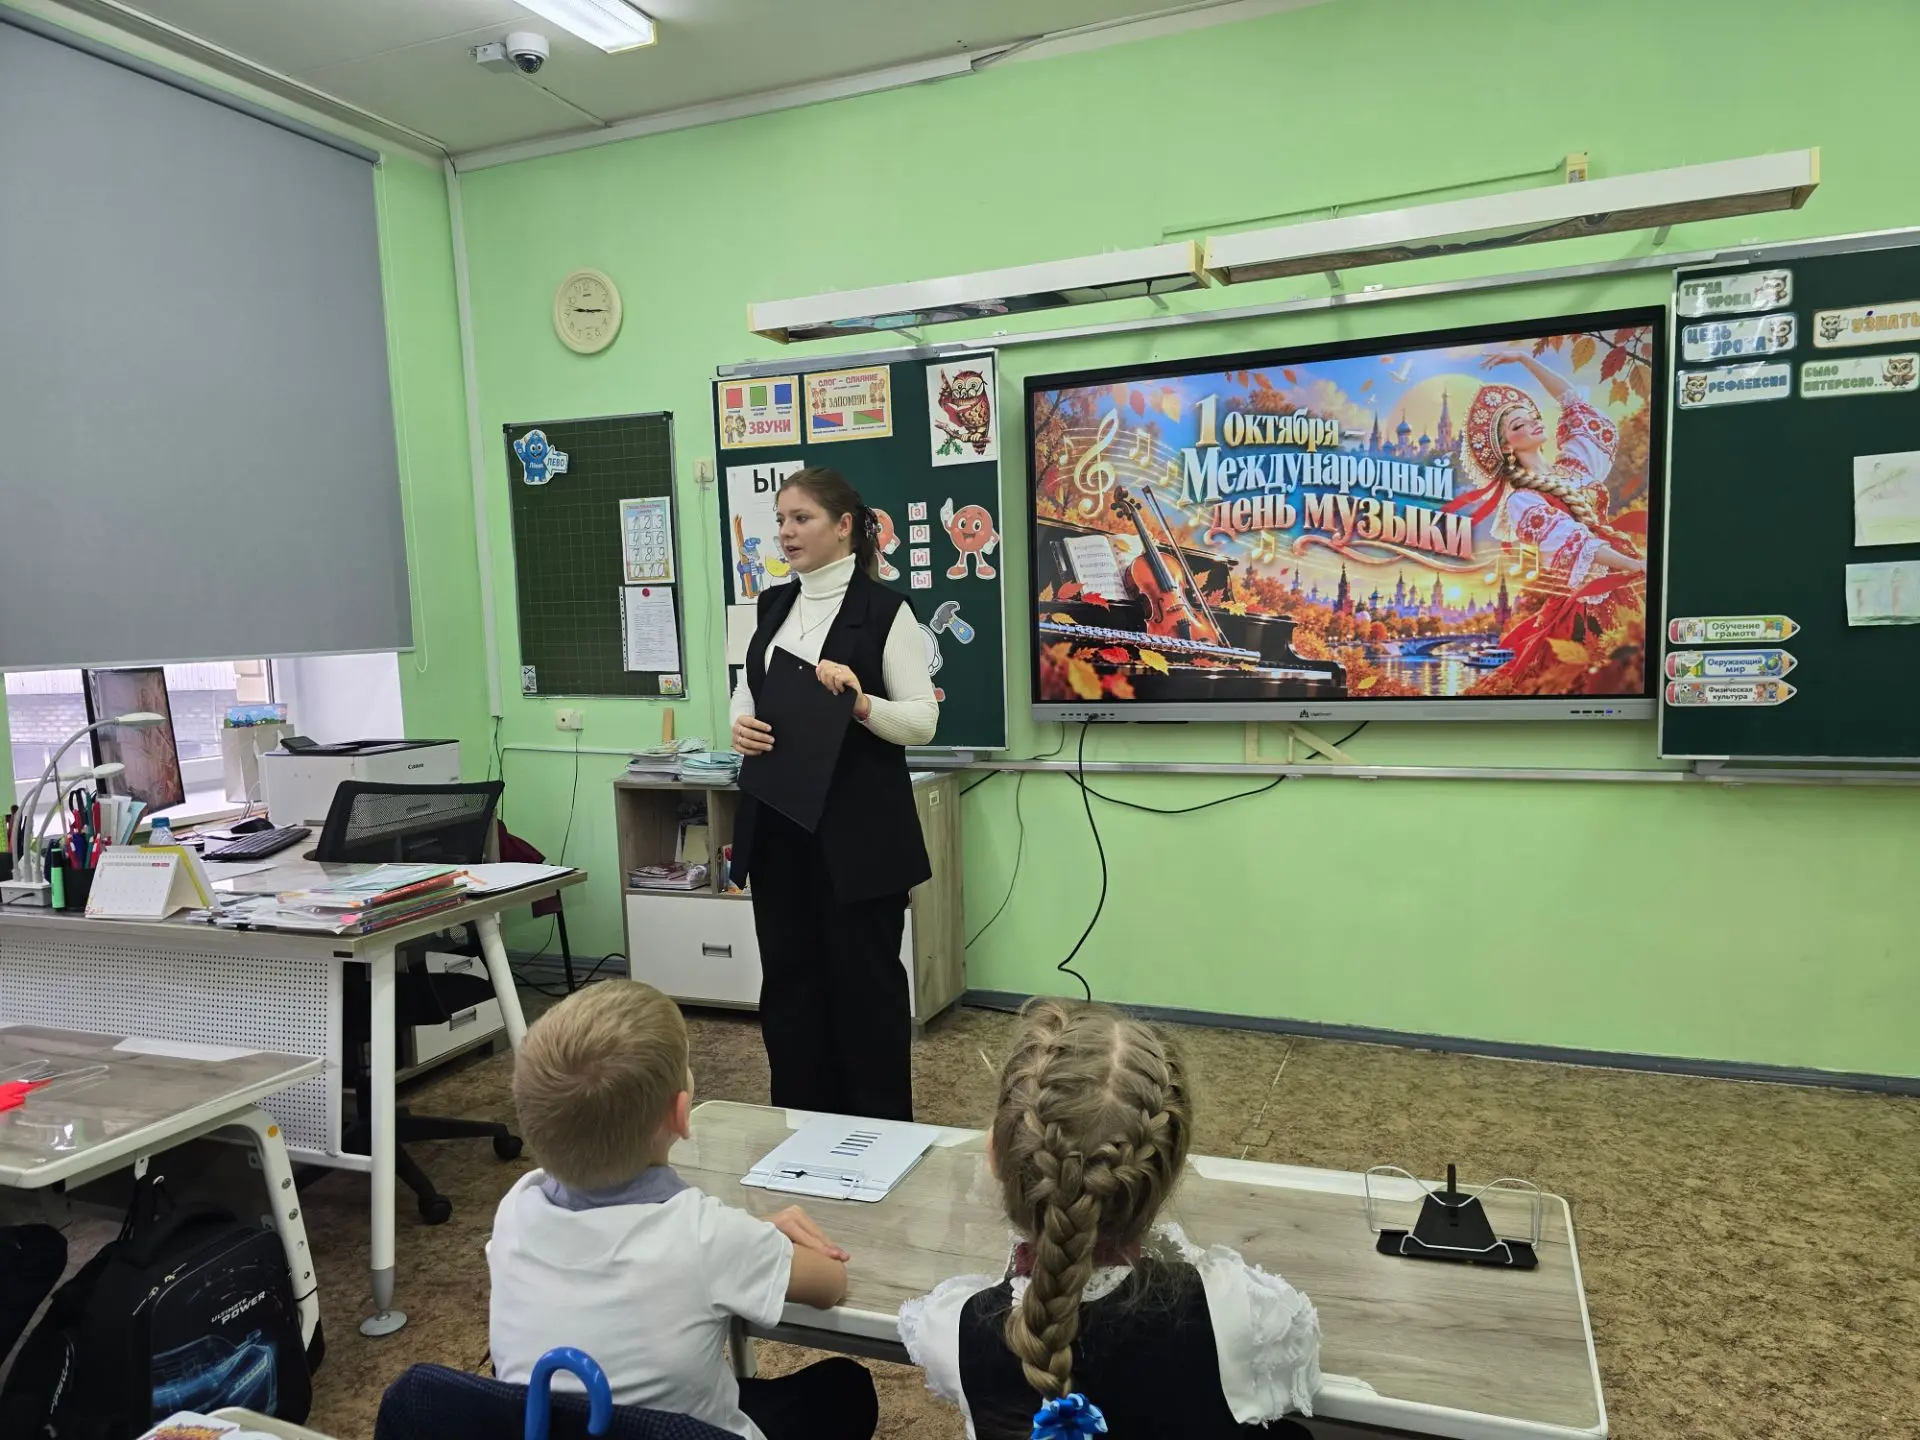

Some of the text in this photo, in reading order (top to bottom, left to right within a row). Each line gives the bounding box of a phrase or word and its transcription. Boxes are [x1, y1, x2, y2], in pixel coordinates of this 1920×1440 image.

[1706, 293, 1752, 309] УРОКА
[1851, 311, 1920, 334] УЗНАТЬ
[1687, 325, 1732, 345] ЦЕЛЬ
[1804, 365, 1839, 378] БЫЛО
[818, 378, 836, 387] СЛОГ
[1708, 375, 1787, 393] РЕФЛЕКСИЯ
[748, 418, 791, 435] ЗВУКИ
[1195, 393, 1219, 447] 1
[547, 457, 565, 467] ЛЕВО
[1177, 446, 1456, 506] Международный
[643, 515, 652, 530] 2
[645, 531, 652, 546] 5
[644, 546, 653, 562] 8
[1711, 622, 1761, 634] Обучение
[1714, 631, 1757, 639] грамоте
[1707, 657, 1763, 668] Окружающий
[1725, 665, 1746, 675] мир
[1708, 686, 1754, 695] Физическая
[1712, 693, 1748, 701] культура
[211, 1297, 247, 1323] ULTIMATE
[221, 1290, 266, 1325] POWER
